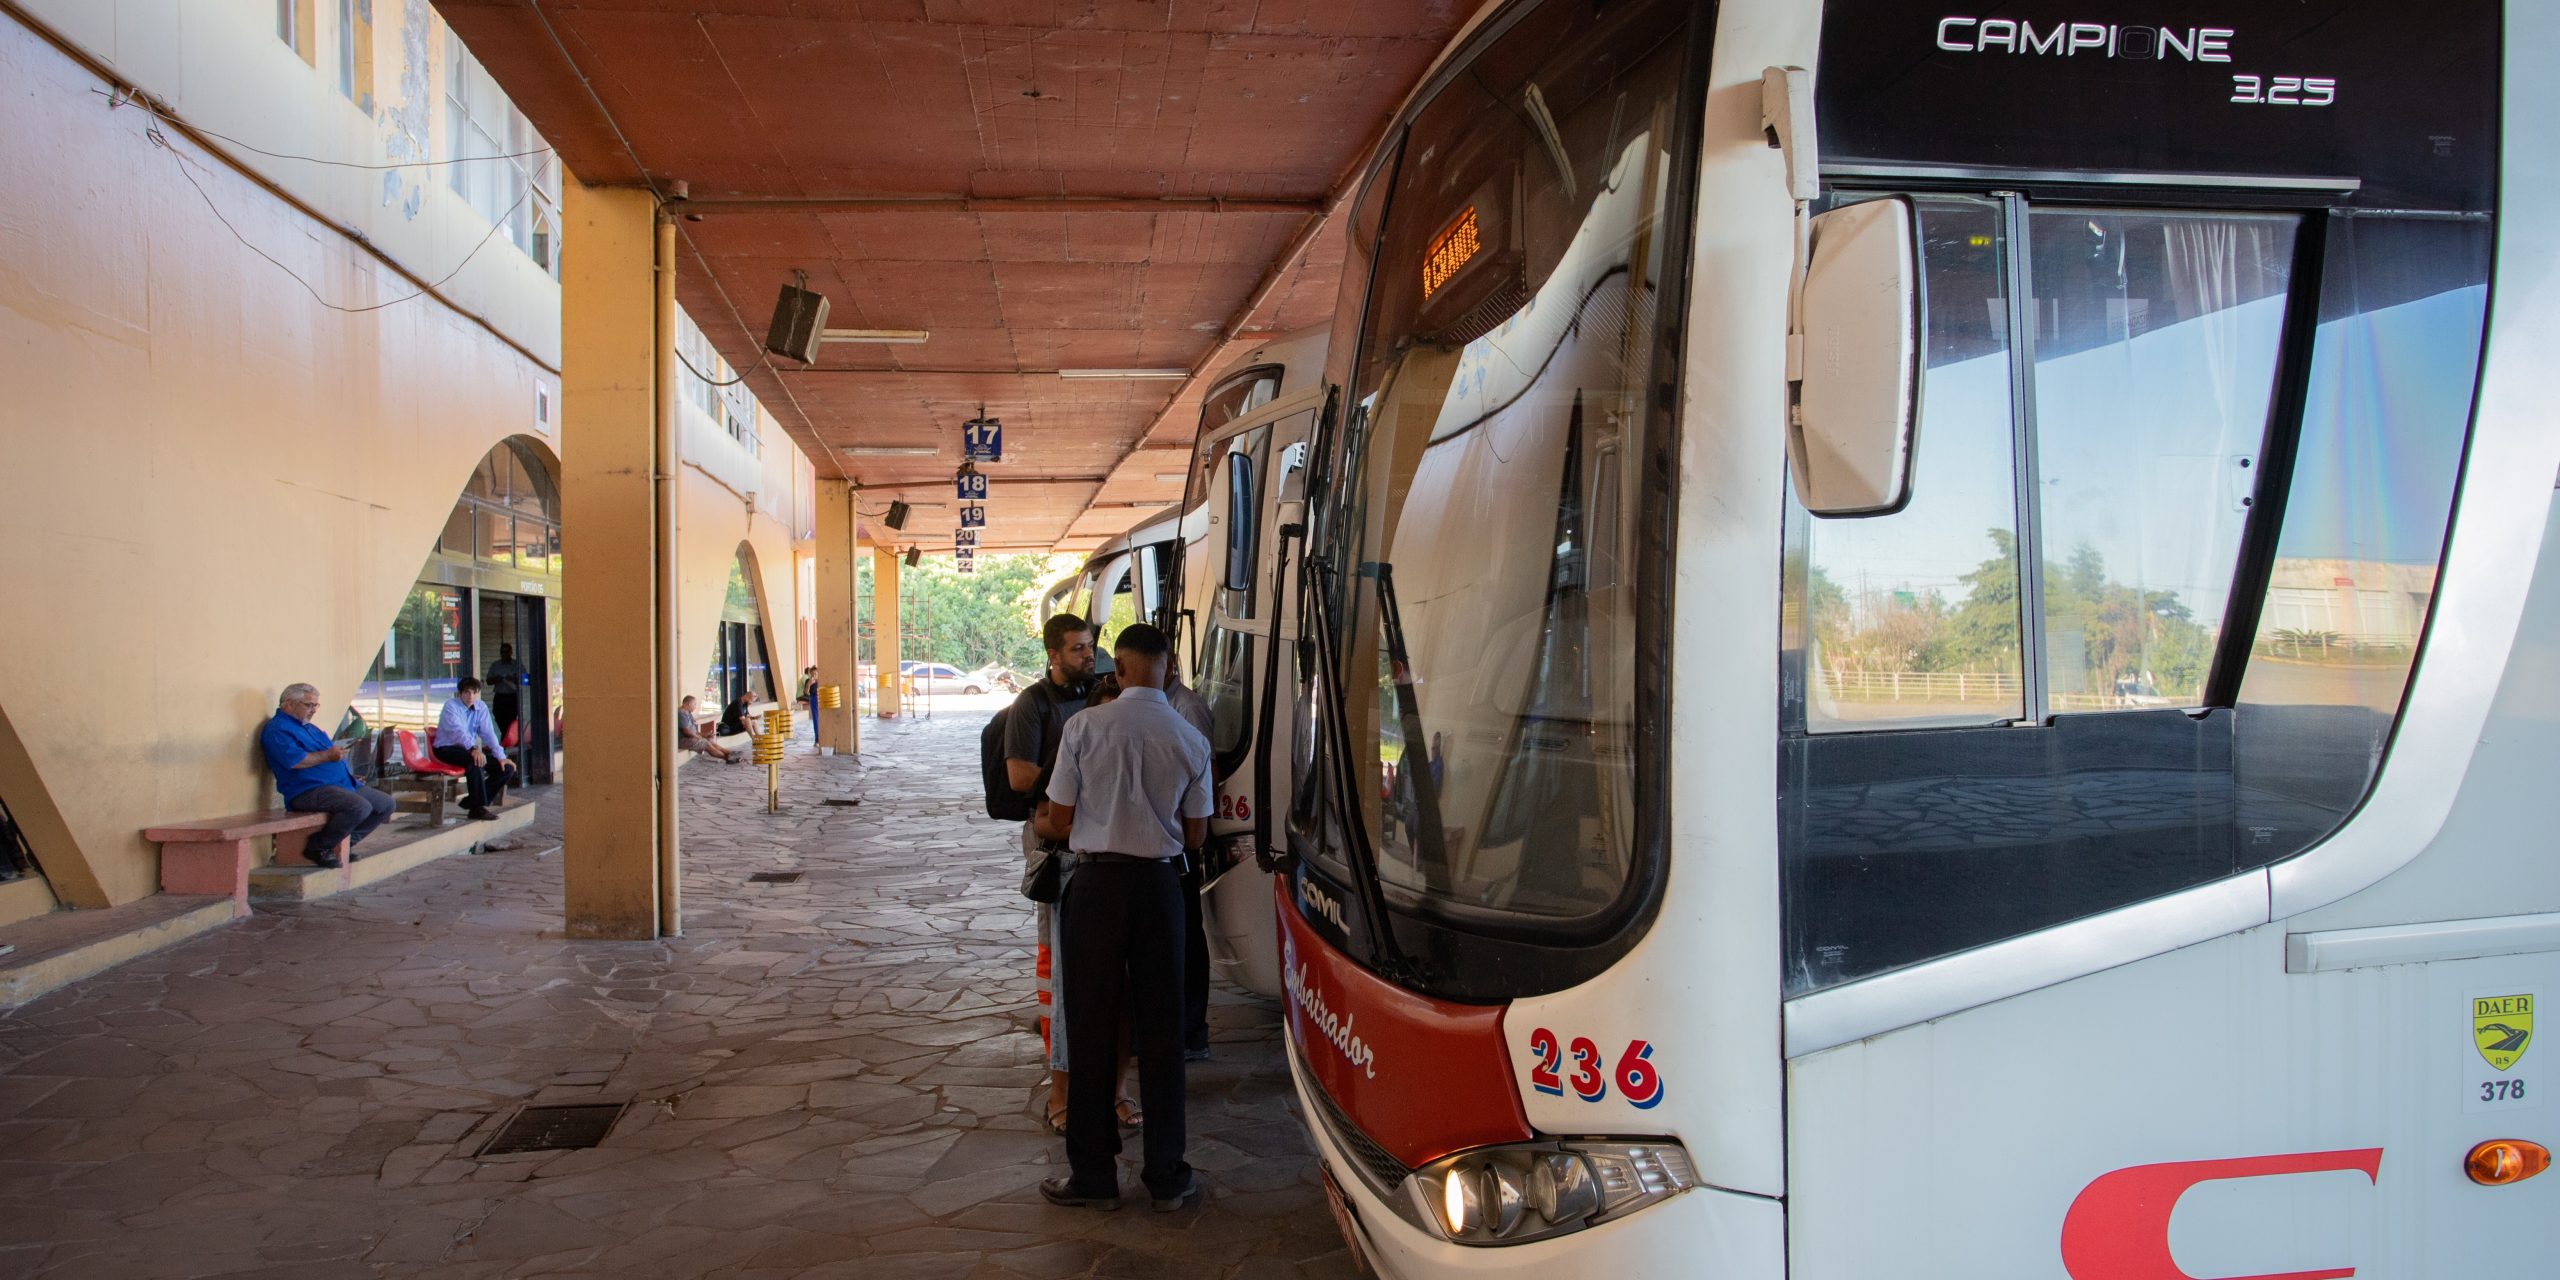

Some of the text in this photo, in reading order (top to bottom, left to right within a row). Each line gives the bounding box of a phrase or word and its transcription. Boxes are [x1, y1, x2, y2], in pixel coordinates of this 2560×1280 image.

[1936, 17, 2234, 63] CAMPIONE
[2230, 74, 2336, 106] 3.25
[1432, 213, 1481, 289] GRANDE
[966, 425, 999, 445] 17
[959, 475, 985, 491] 18
[961, 508, 983, 522] 19
[956, 529, 974, 541] 20
[1301, 876, 1350, 936] COMIL
[2478, 998, 2529, 1016] DAER
[1530, 1027, 1664, 1110] 236
[2495, 1056, 2510, 1065] RS
[2480, 1079, 2526, 1102] 378
